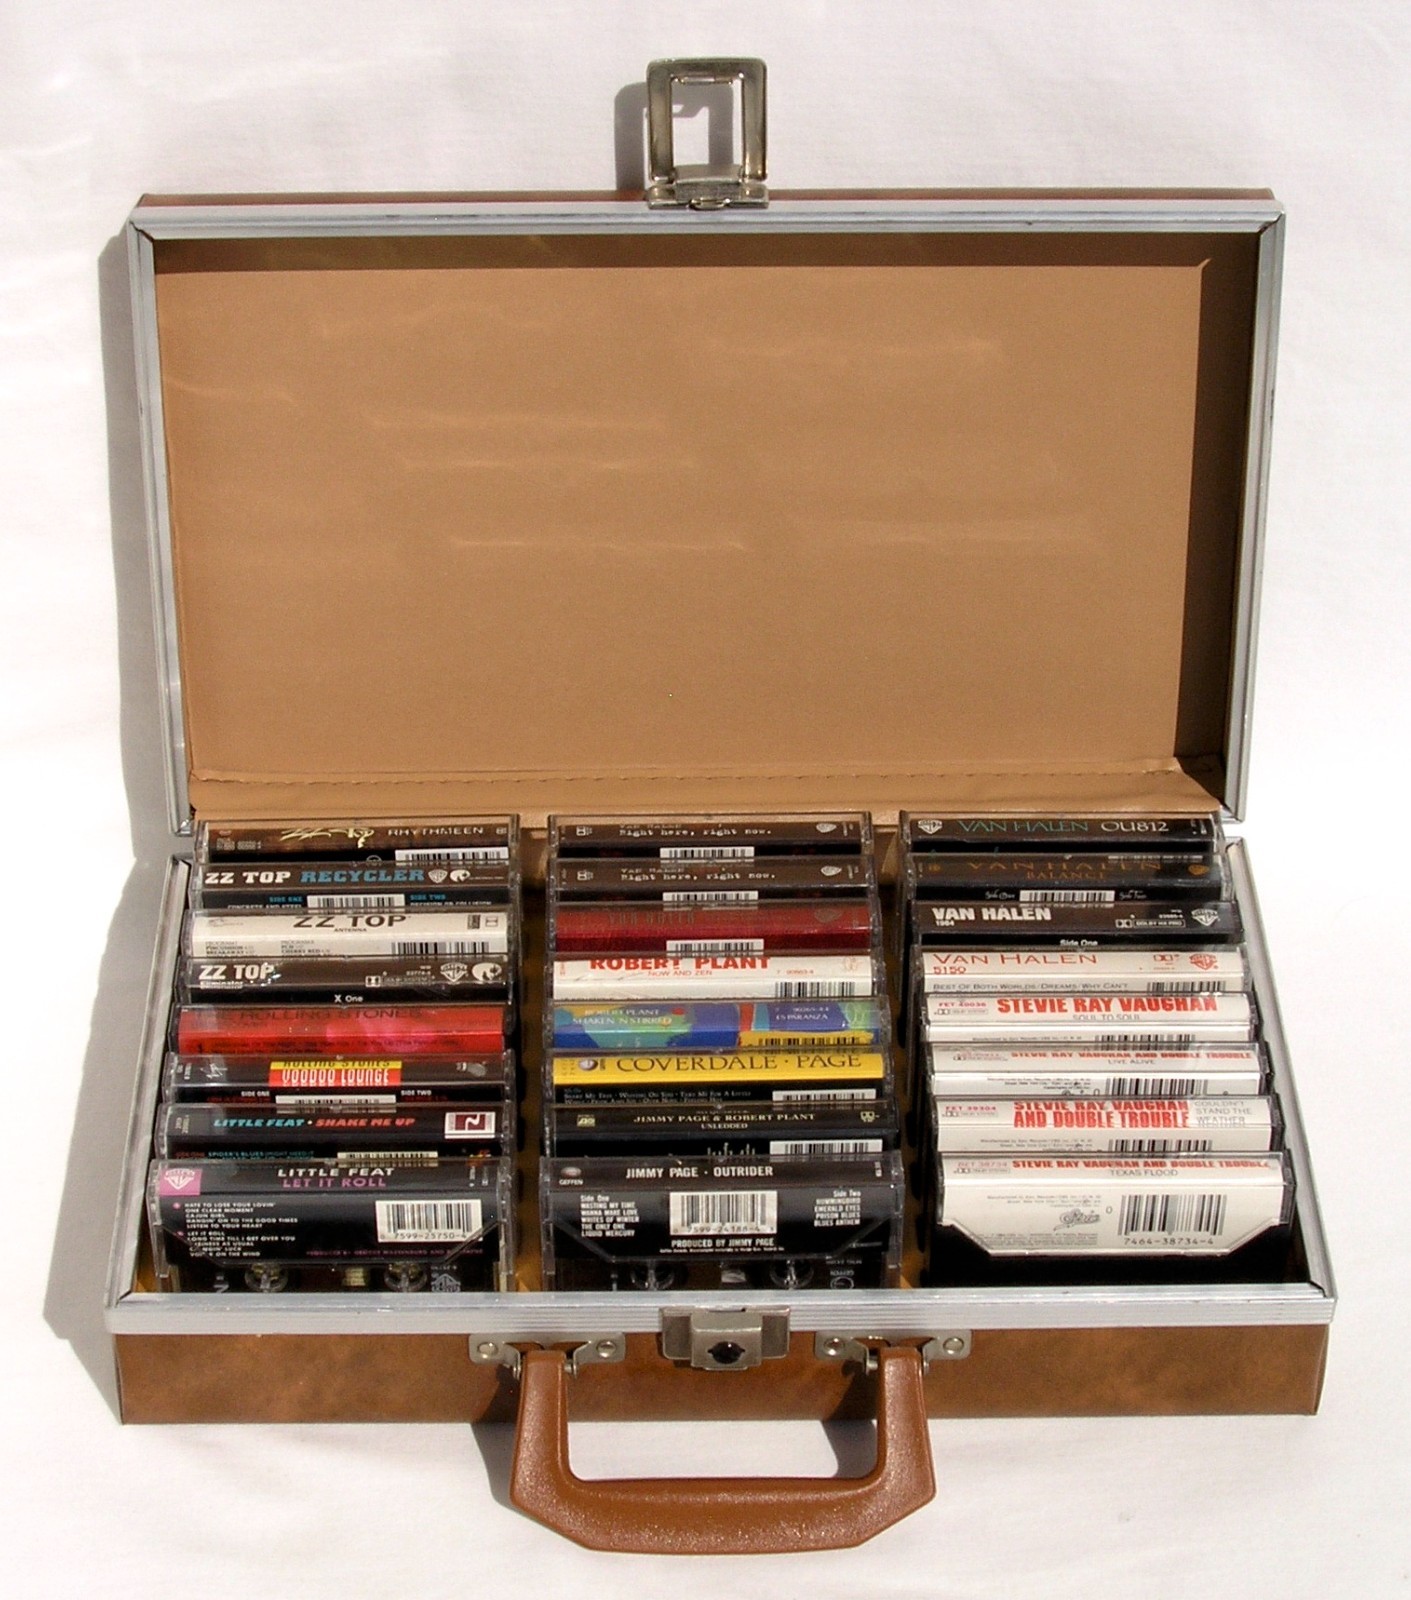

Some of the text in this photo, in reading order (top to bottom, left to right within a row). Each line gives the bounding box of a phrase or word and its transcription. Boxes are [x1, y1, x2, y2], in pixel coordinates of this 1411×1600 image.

[957, 820, 1169, 832] VAN HALEN OU812
[387, 827, 484, 837] RHYTHMEEN
[619, 827, 772, 838] Right here, right now.
[967, 862, 1034, 870] VAN
[205, 868, 425, 885] ZZ TOP RECYCLER
[620, 873, 656, 882] Right
[663, 873, 698, 881] here,
[706, 872, 741, 881] right
[1026, 872, 1107, 880] BALANCE
[931, 907, 1052, 921] VAN HALEN
[293, 915, 406, 928] ZZ TOP
[589, 957, 771, 970] ROBERT PLANT
[933, 954, 1098, 965] VAN HALEN
[199, 963, 274, 980] ZZ TOP
[933, 966, 967, 974] 5150
[345, 994, 363, 1002] One
[997, 996, 1218, 1013] STEVIE RAY VAUGHAN
[616, 1054, 862, 1072] COVERDALE PAGE
[282, 1068, 389, 1087] VOODOO LOUNGE
[1013, 1100, 1189, 1111] STEVIE RAY VAUGHAN
[213, 1117, 416, 1127] LITTLE FEAT SHAKE ME UP
[633, 1113, 816, 1123] JIMMY PAGE & ROBERT PLANT
[1013, 1111, 1190, 1128] AND DOUBLE TROUBLE
[1196, 1116, 1245, 1127] WEATHER
[1012, 1160, 1053, 1168] STEVIE
[1056, 1160, 1080, 1168] RAY
[1083, 1160, 1139, 1168] VAUGHAN
[1219, 1160, 1271, 1168] TROUBLE
[277, 1167, 395, 1177] LITTLE FEAT
[626, 1166, 773, 1179] JIMMY PAGE OUTRIDER
[282, 1177, 387, 1188] LET IT ROLL
[833, 1189, 862, 1198] Side Two
[621, 1201, 636, 1209] TIME
[581, 1230, 603, 1238] LIQUID
[671, 1238, 775, 1248] PRODUCED BY JIMMY PAGE
